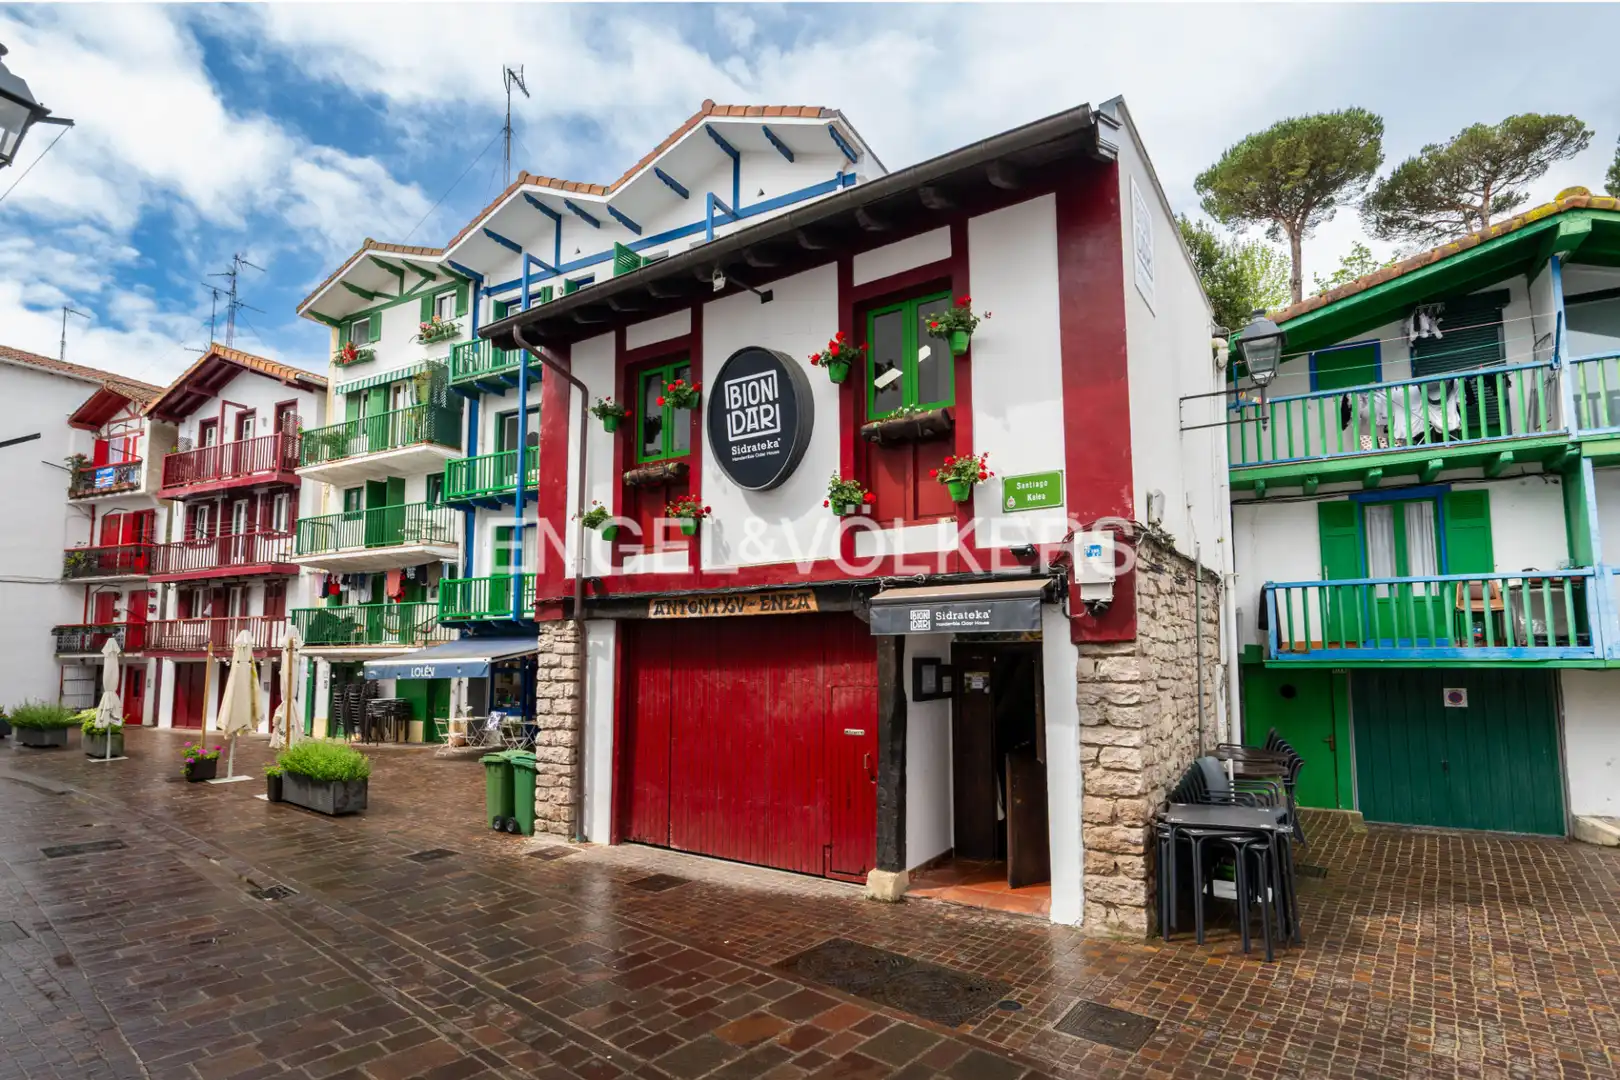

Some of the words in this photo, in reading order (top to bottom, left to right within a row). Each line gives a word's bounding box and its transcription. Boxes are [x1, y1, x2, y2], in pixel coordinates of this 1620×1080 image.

[730, 377, 773, 410] BION
[731, 405, 775, 435] DAR
[731, 440, 780, 456] Sidrateka
[1016, 480, 1048, 490] Santiago
[1027, 493, 1046, 502] Kalea
[935, 610, 989, 621] Sidrateka
